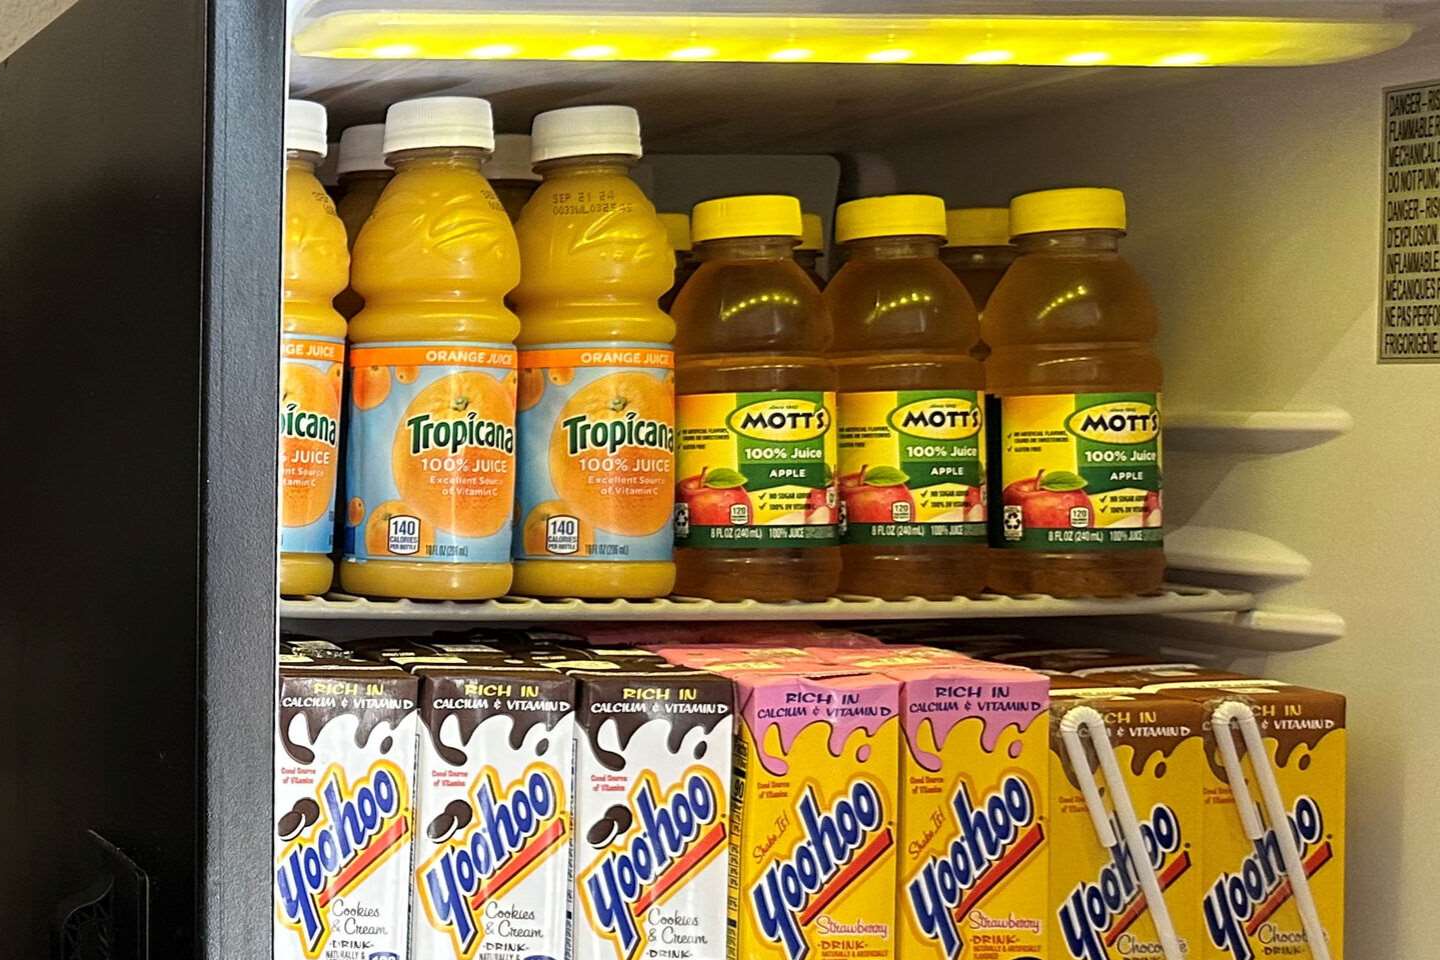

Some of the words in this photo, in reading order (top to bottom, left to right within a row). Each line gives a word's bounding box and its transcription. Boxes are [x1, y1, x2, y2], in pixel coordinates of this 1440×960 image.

[426, 350, 485, 363] ORANGE
[581, 352, 640, 364] ORANGE
[407, 412, 514, 455] Tropicana
[563, 412, 674, 455] Tropicana
[745, 447, 787, 459] 100%
[790, 447, 822, 459] Juice
[906, 446, 948, 457] 100%
[950, 446, 977, 457] Juice
[1085, 450, 1127, 462] 100%
[1130, 450, 1156, 462] Juice
[422, 458, 468, 472] 100%
[473, 459, 508, 473] JUICE
[579, 458, 628, 472] 100%
[634, 459, 670, 473] JUICE
[930, 467, 964, 476] APPLE
[769, 469, 806, 478] APPLE
[1110, 471, 1143, 481] APPLE
[392, 520, 415, 535] 140
[551, 520, 574, 535] 140
[314, 684, 356, 696] RICH
[367, 684, 384, 696] IN
[464, 684, 511, 697] RICH
[520, 685, 539, 697] IN
[623, 688, 670, 700] RICH
[679, 688, 697, 700] IN
[935, 686, 982, 698] RICH
[991, 686, 1010, 698] IN
[282, 697, 335, 708] CALCIUM
[433, 699, 488, 709] CALCIUM
[786, 692, 832, 704] RICH
[842, 694, 860, 704] IN
[591, 702, 647, 713] CALCIUM
[757, 707, 806, 719] CALCIUM
[910, 702, 958, 713] CALCIUM
[332, 899, 379, 917] Cookies
[485, 901, 535, 920] Cookies
[648, 908, 699, 926] Cookies
[344, 918, 388, 934] Cream
[498, 920, 544, 937] Cream
[661, 926, 708, 944] Cream
